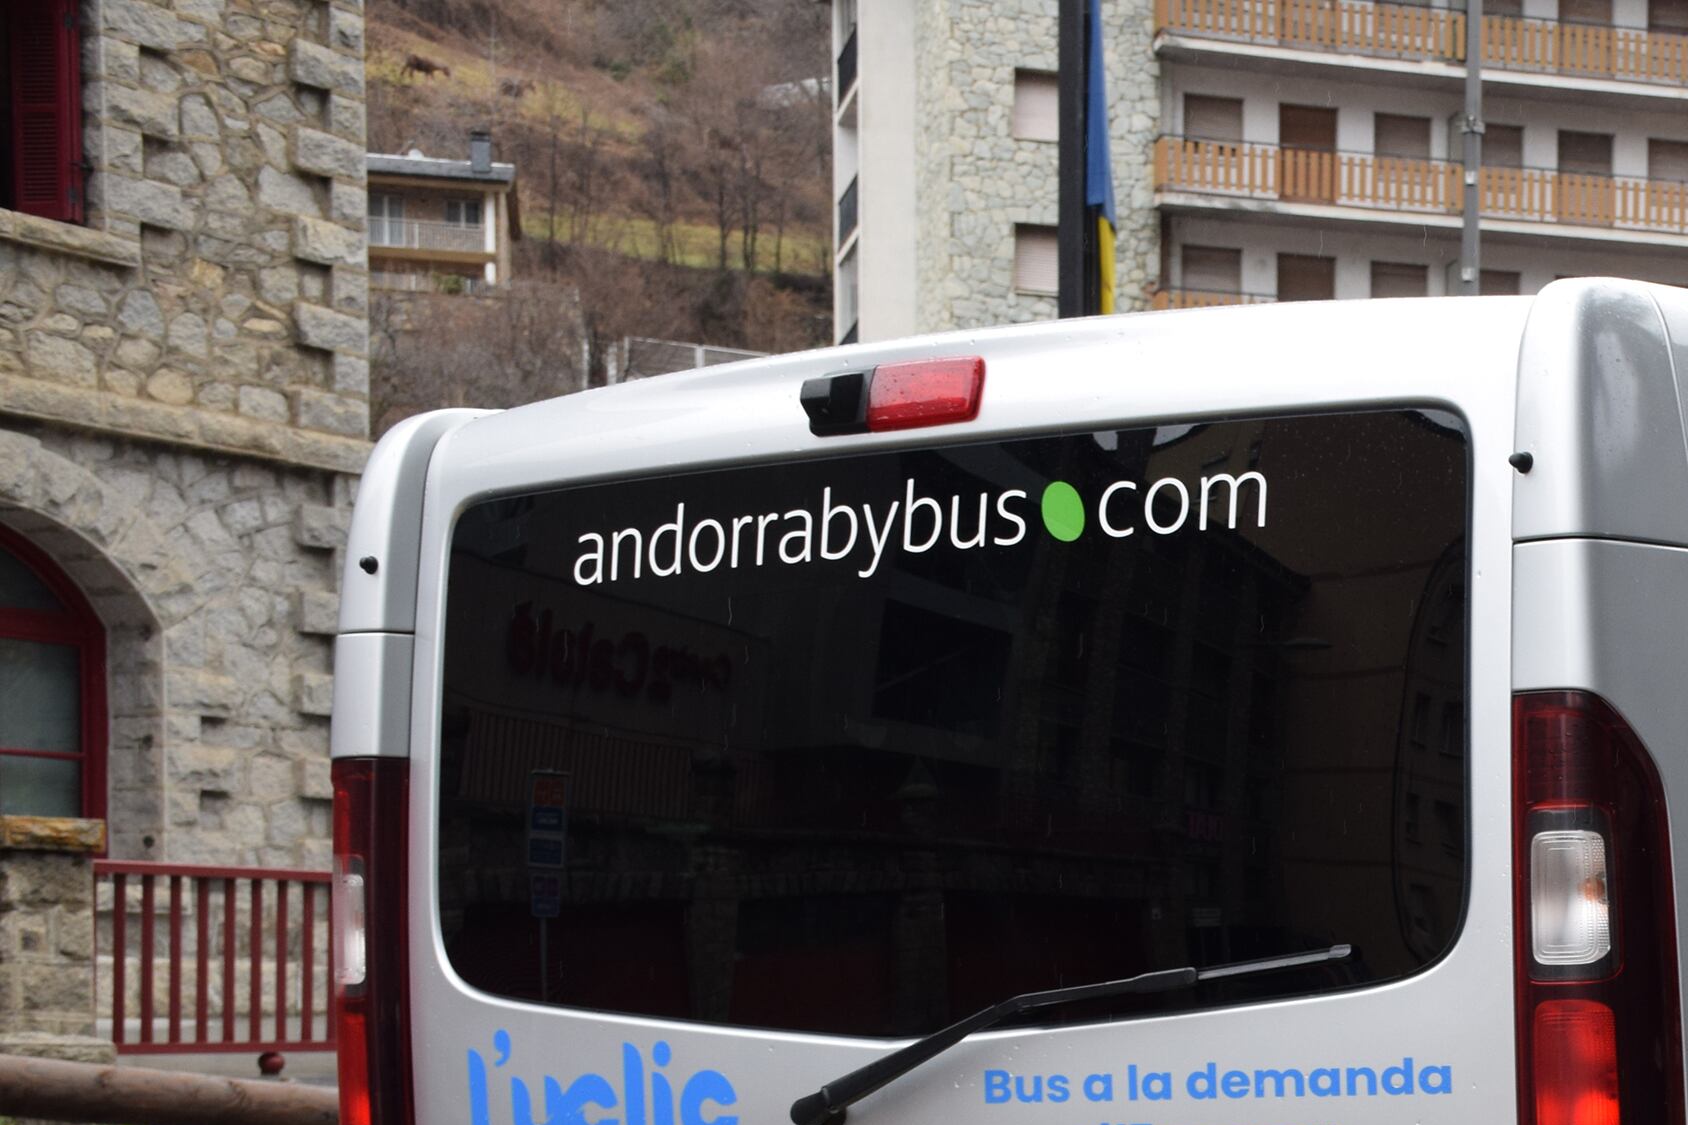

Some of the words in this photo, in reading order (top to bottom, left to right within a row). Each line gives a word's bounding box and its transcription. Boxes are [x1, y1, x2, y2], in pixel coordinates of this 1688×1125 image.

[984, 1069, 1070, 1104] Bus
[1083, 1073, 1113, 1101] a
[1128, 1064, 1172, 1101] la
[1186, 1057, 1453, 1099] demanda
